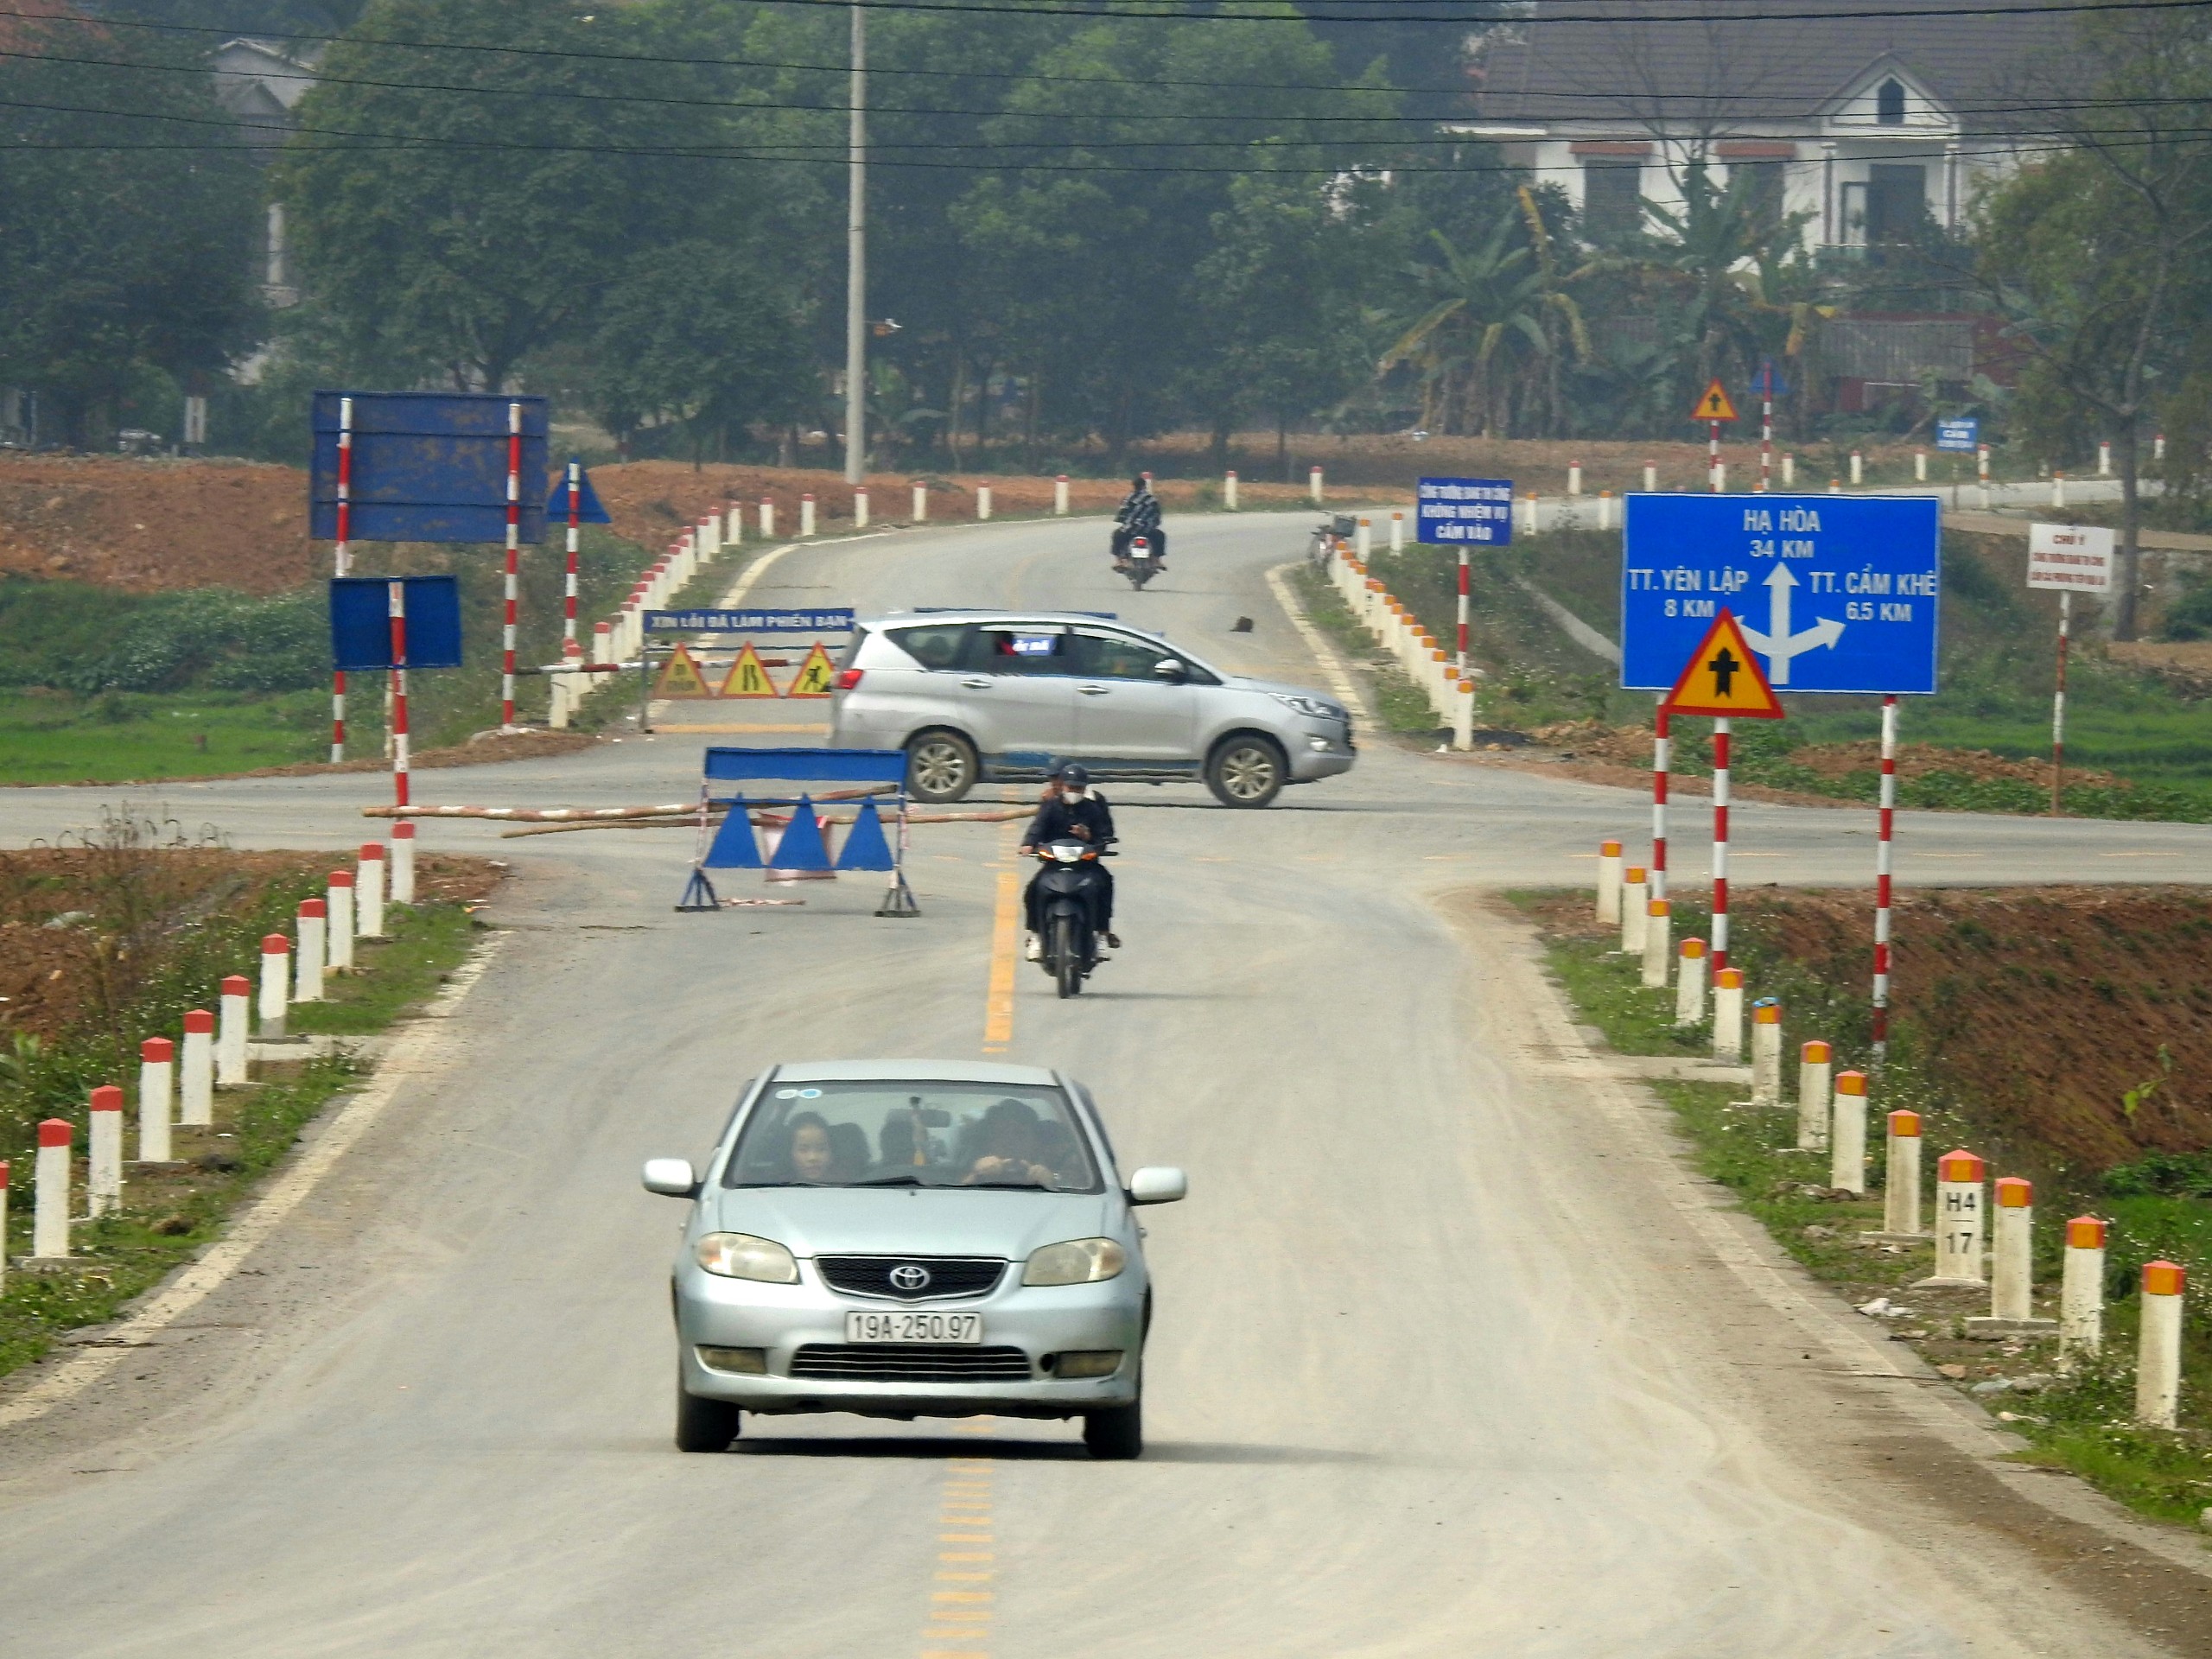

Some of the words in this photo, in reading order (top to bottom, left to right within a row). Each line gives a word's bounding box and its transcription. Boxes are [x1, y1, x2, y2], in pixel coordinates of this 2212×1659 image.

[1743, 508, 1773, 536] HẠ
[1778, 505, 1822, 533] HÒA
[1749, 539, 1776, 558] 34
[1781, 539, 1815, 559] KM
[1660, 565, 1702, 592] YÊN
[1707, 565, 1750, 595] LẬP
[1896, 569, 1937, 597] KHÊ
[1663, 598, 1678, 618] 8
[1682, 599, 1715, 619] KM
[1879, 602, 1912, 623] KM
[731, 614, 764, 627] LÀM
[1945, 1192, 1976, 1212] H4
[1945, 1232, 1973, 1254] 17
[855, 1314, 976, 1339] 19A-250.97
